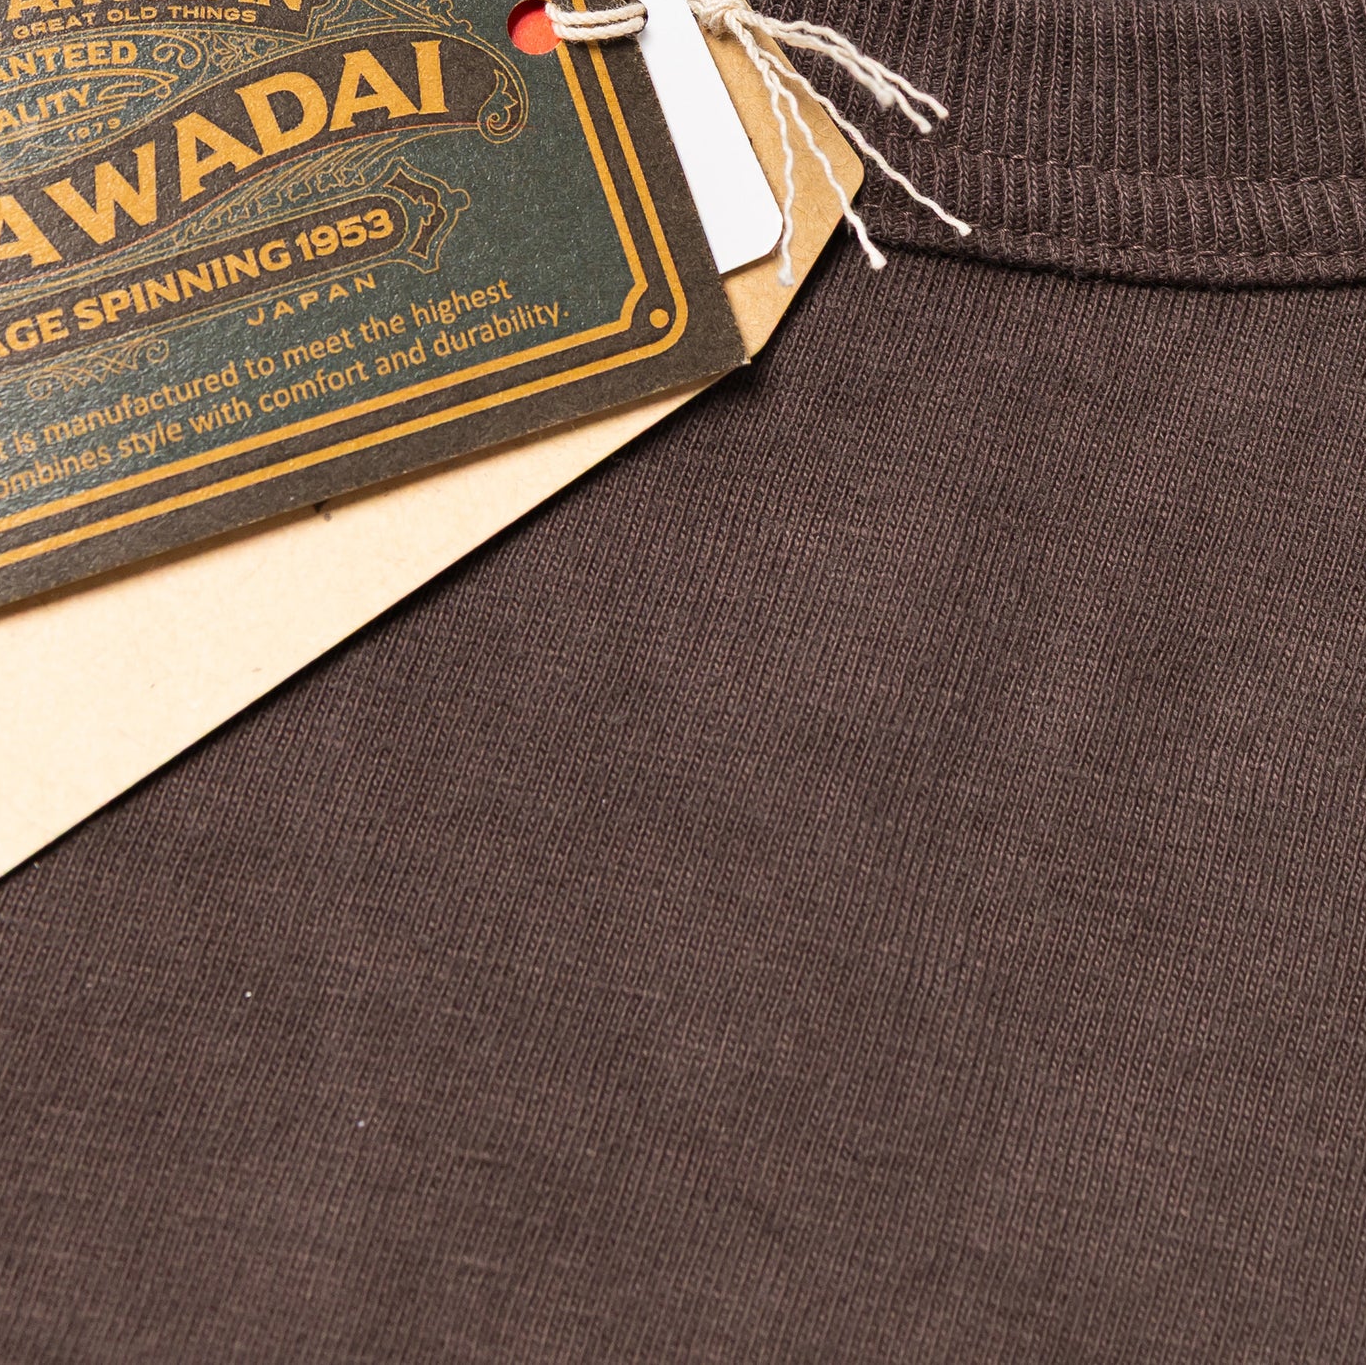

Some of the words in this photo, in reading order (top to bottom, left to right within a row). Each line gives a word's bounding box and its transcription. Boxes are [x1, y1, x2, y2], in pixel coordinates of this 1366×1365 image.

[12, 12, 98, 40] GREAT
[106, 6, 158, 24] OLD
[170, 6, 258, 25] THINGS
[67, 117, 122, 141] 1979
[73, 239, 293, 331] SPINNING
[295, 208, 395, 262] 1953
[246, 272, 377, 327] JAPAN
[13, 429, 37, 455] is
[42, 360, 240, 447] manufactured
[243, 354, 276, 381] to
[281, 329, 356, 373] meet
[358, 311, 407, 346] the
[409, 278, 514, 325] highest
[117, 421, 184, 458] style
[187, 396, 253, 435] with
[257, 360, 370, 414] comfort
[375, 339, 428, 377] and
[432, 301, 571, 359] durability.
